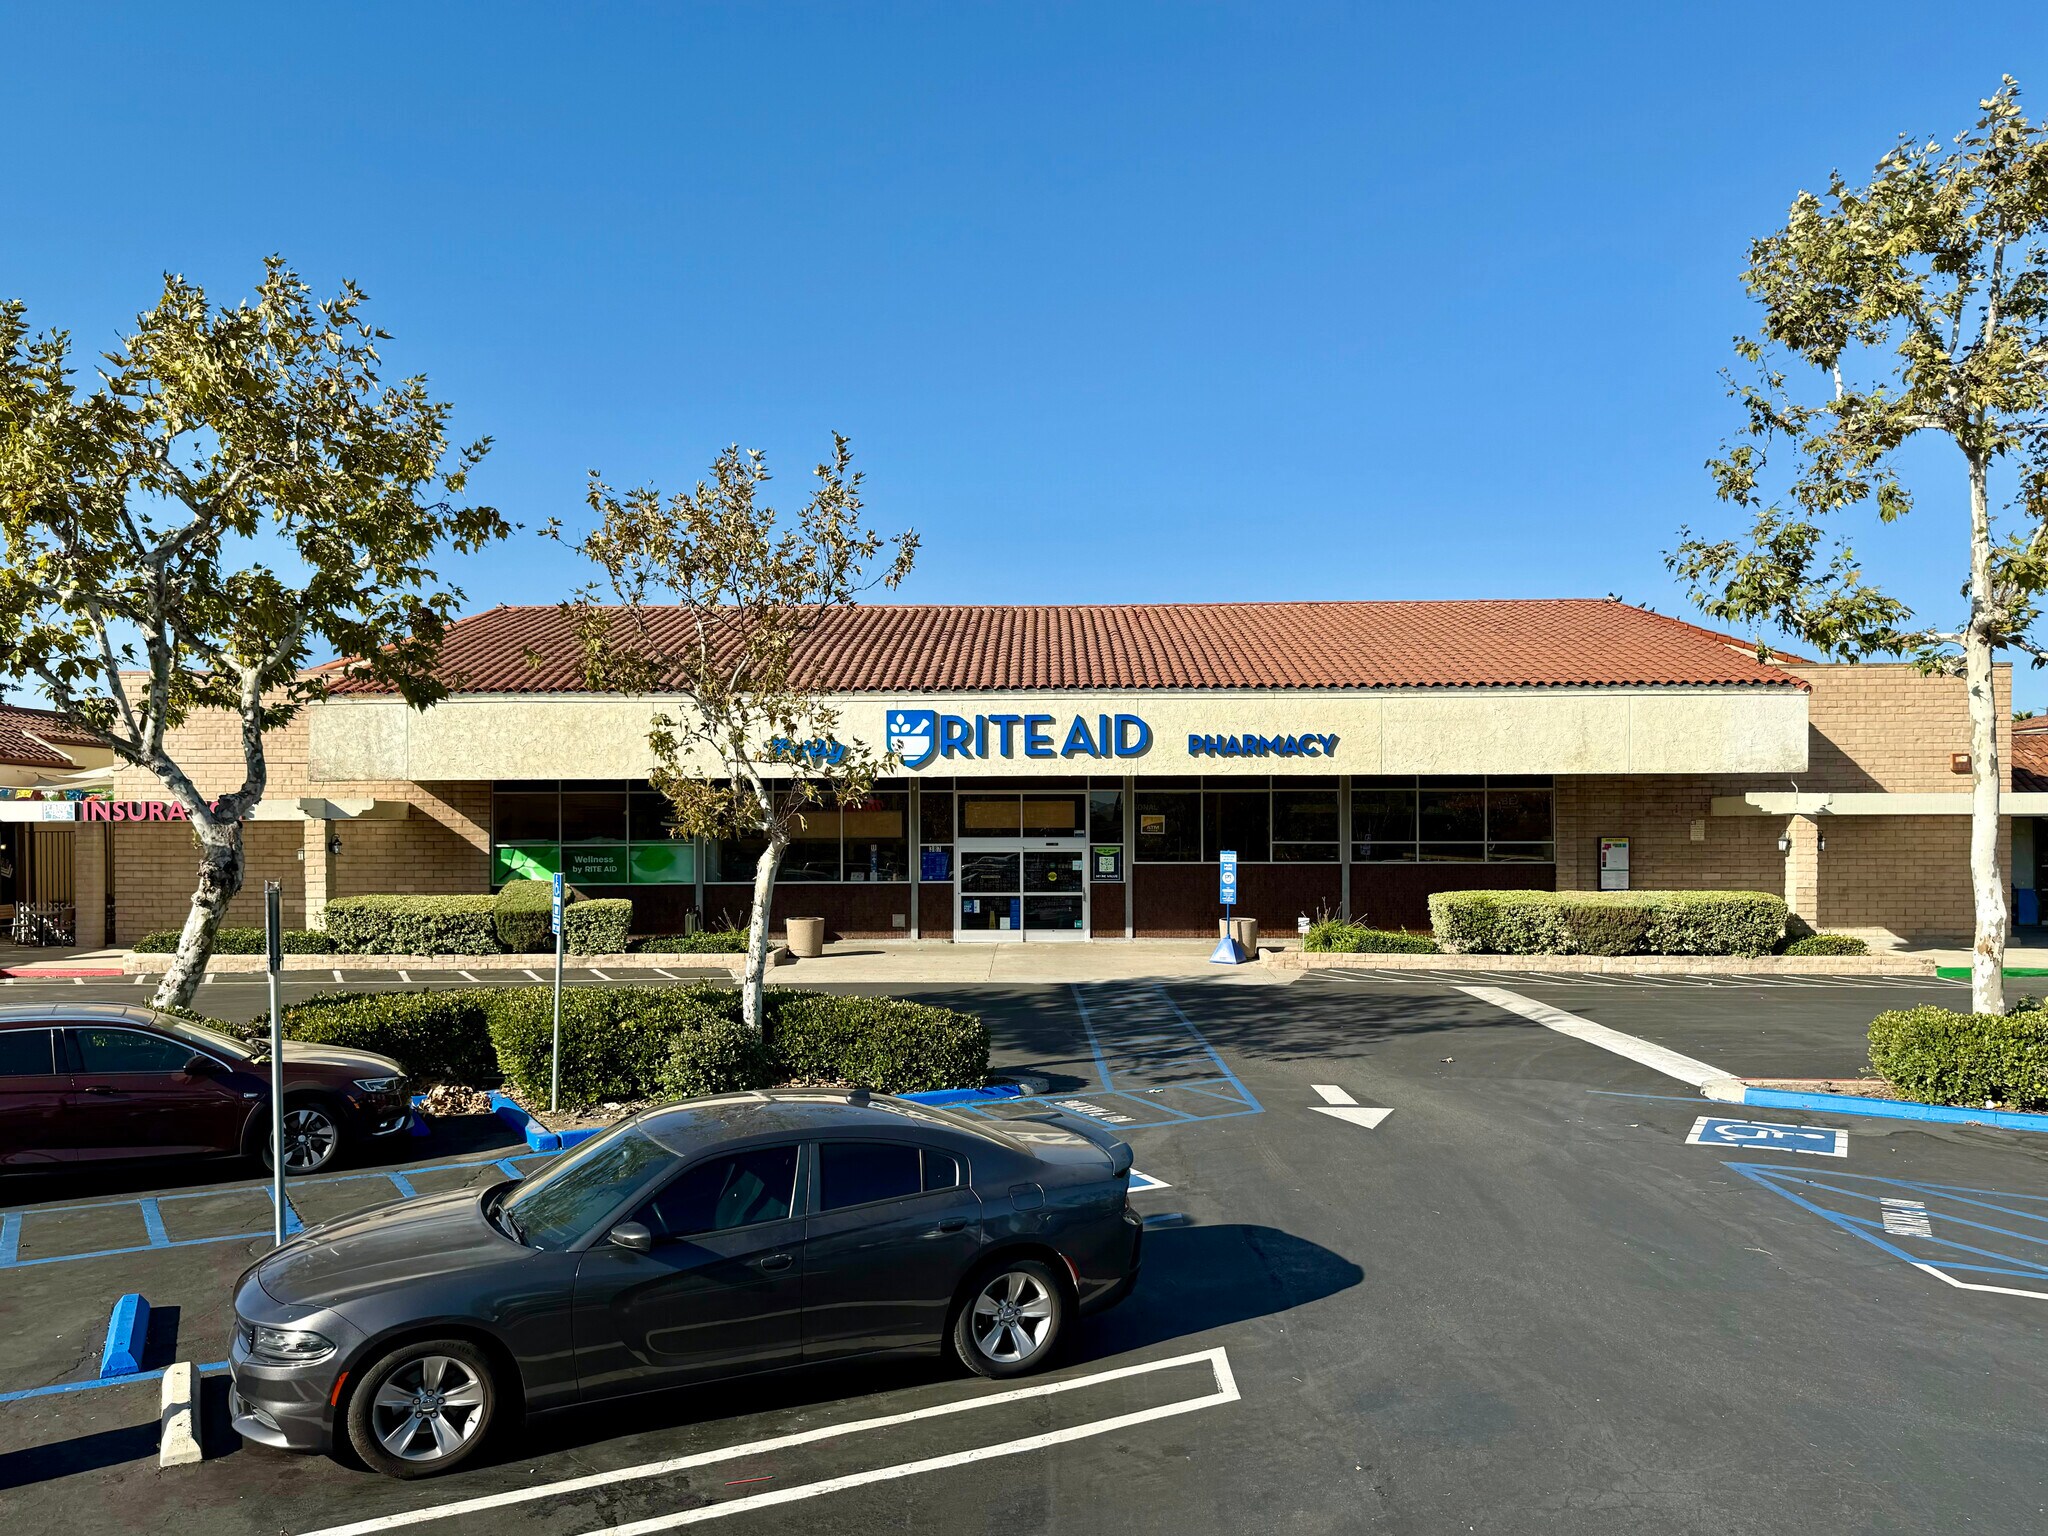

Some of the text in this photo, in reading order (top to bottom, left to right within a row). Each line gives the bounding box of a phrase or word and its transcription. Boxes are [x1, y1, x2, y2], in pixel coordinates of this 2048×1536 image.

[940, 714, 1150, 757] RITE AID
[1188, 733, 1337, 757] PHARMACY
[82, 800, 243, 821] INSURA
[572, 865, 618, 874] by RITE AID
[574, 855, 614, 863] Wellness
